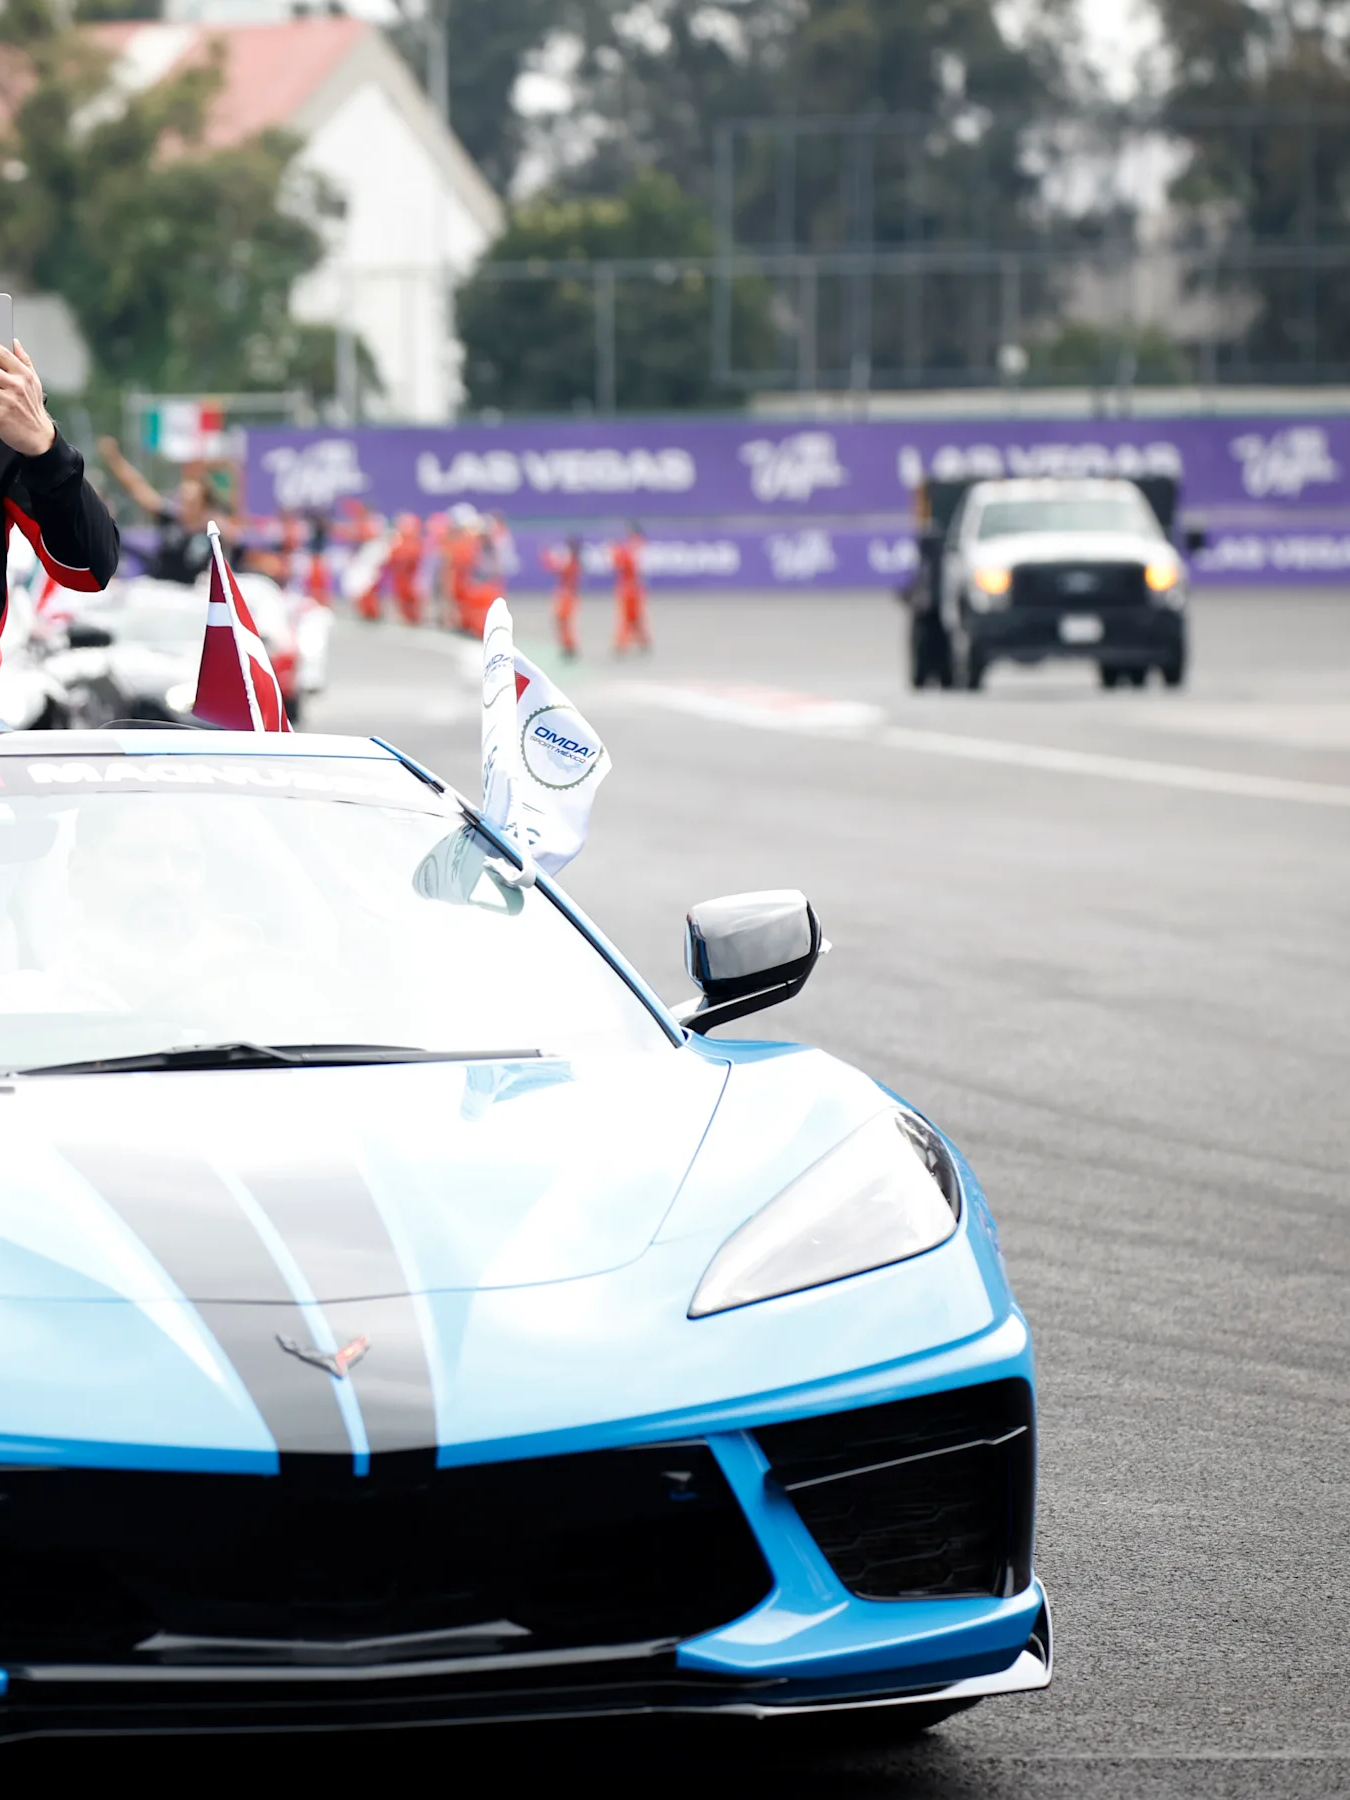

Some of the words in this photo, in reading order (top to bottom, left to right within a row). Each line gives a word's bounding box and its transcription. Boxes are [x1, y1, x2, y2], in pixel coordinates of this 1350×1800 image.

[417, 449, 520, 494] LAS
[525, 447, 696, 493] VEGAS
[530, 735, 557, 751] SPORT
[534, 726, 596, 758] OMDAI
